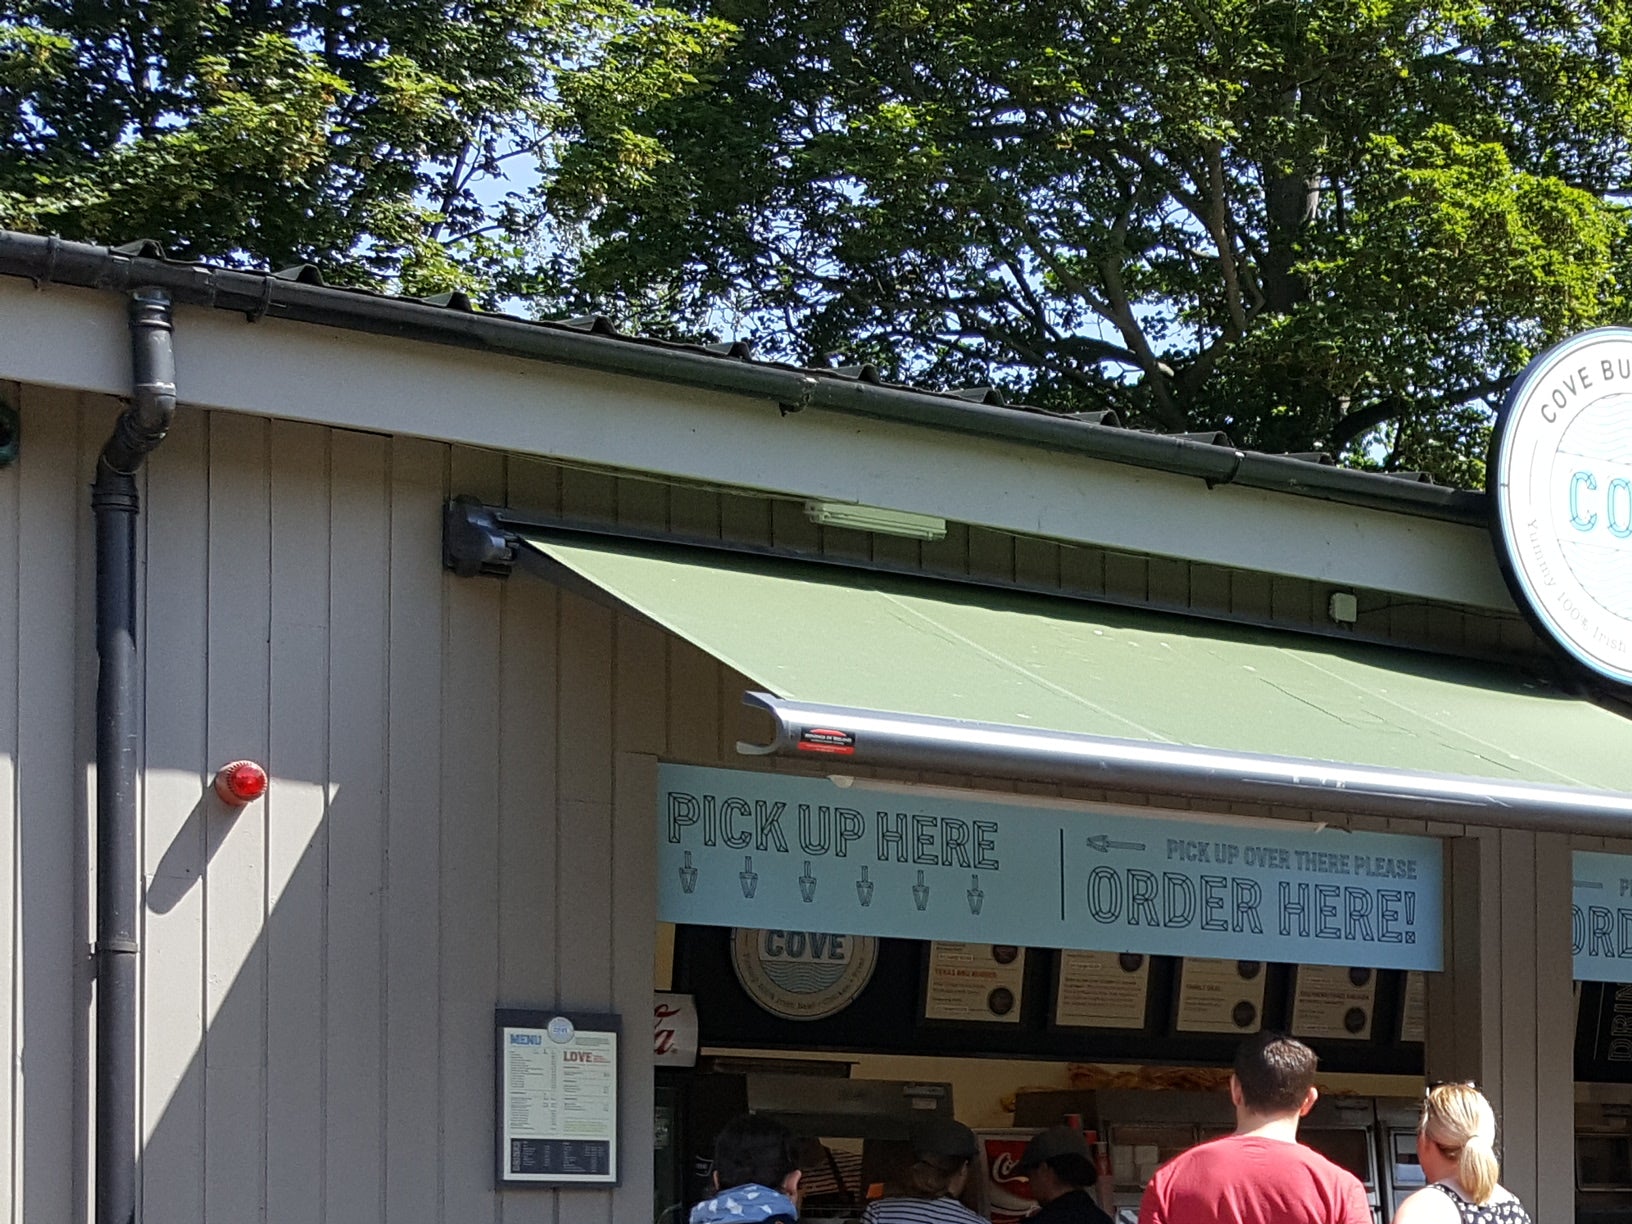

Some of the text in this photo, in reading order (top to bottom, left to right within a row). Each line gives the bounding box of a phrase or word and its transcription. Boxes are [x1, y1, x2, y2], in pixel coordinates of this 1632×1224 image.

[1541, 366, 1594, 424] COVE
[1557, 592, 1590, 632] 100%
[1593, 626, 1628, 653] Irish
[667, 790, 1000, 871] PICK UP HERE
[1166, 837, 1418, 881] PICK UP OVER THERE PLEASE
[1086, 864, 1417, 945] ORDER HERE!
[764, 931, 846, 961] COVE
[509, 1033, 543, 1047] MENU
[563, 1051, 593, 1064] LOVE
